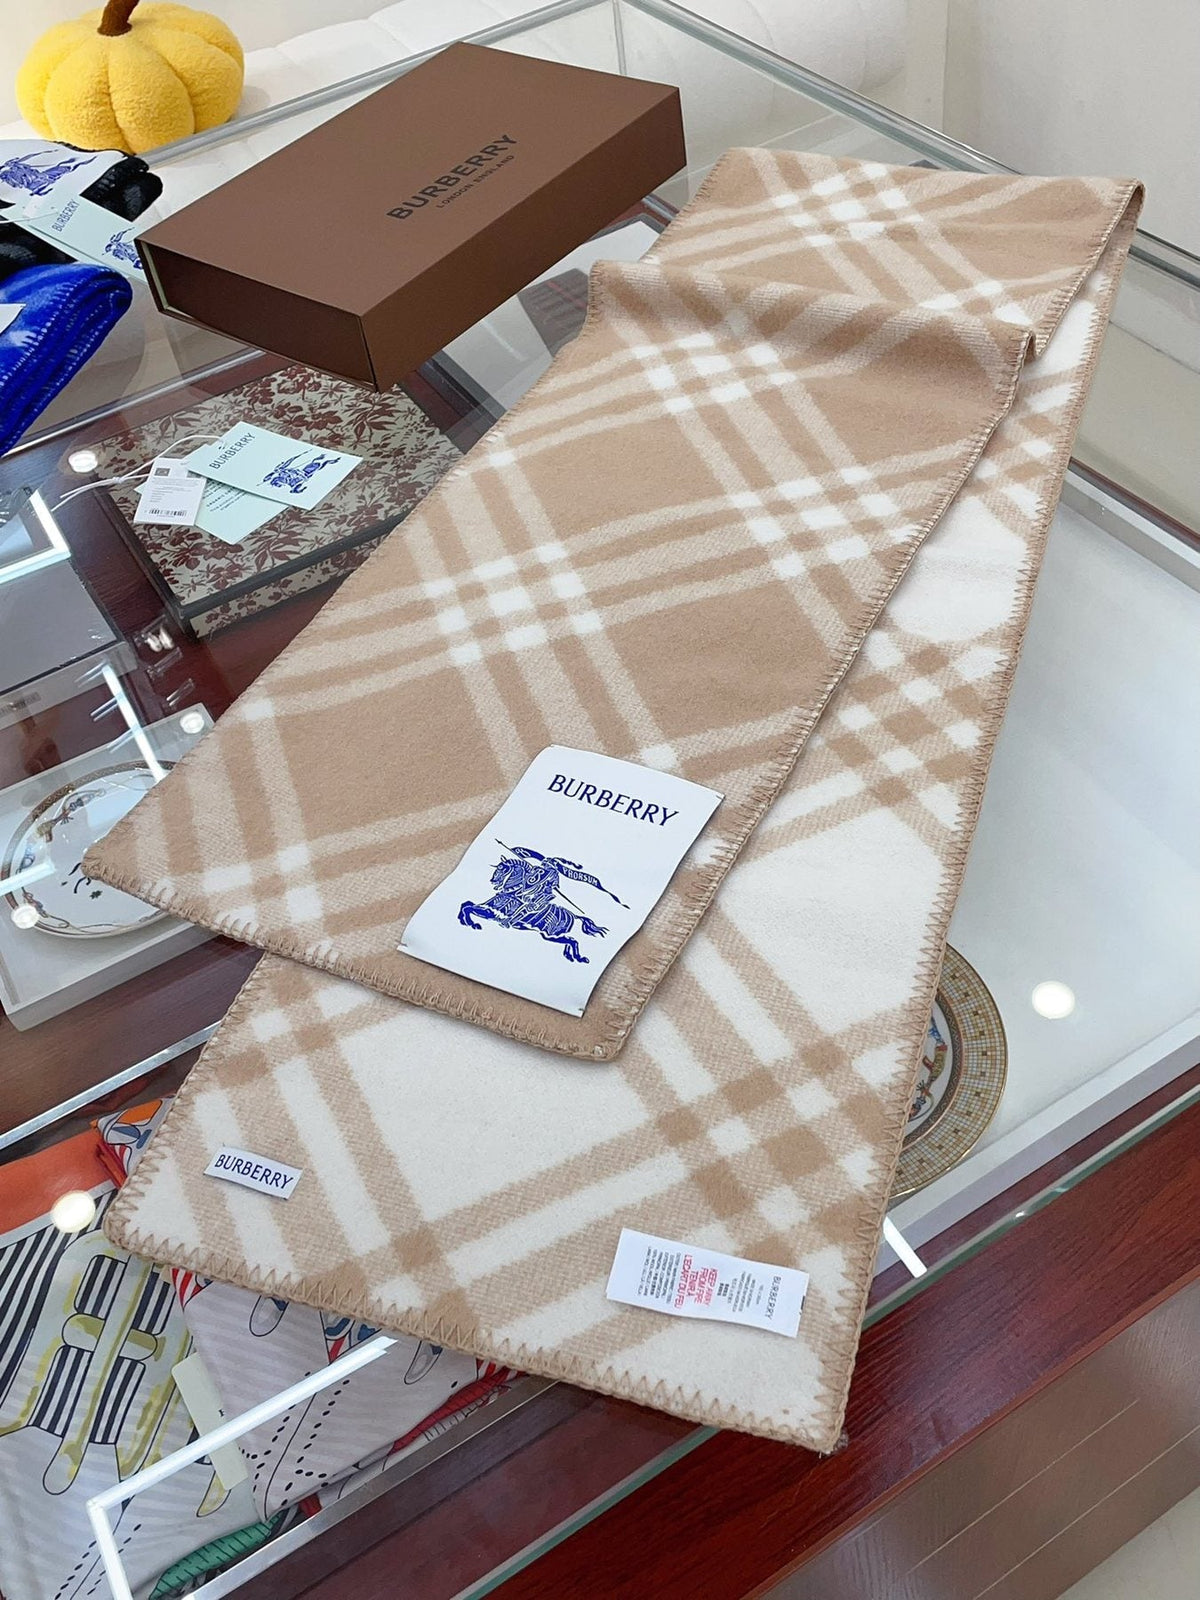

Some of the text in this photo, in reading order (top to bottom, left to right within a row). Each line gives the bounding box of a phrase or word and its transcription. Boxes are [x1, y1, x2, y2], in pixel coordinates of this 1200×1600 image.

[386, 134, 518, 220] BURBERRY
[436, 154, 516, 209] LONDON ENGLAND
[51, 199, 80, 232] BURBERRY
[208, 432, 256, 470] BURBERRY
[547, 773, 680, 827] BURBERRY
[214, 1153, 294, 1190] BURBERRY
[698, 1267, 709, 1288] FROM
[707, 1268, 718, 1287] KEEP
[765, 1275, 782, 1320] BURBERRY
